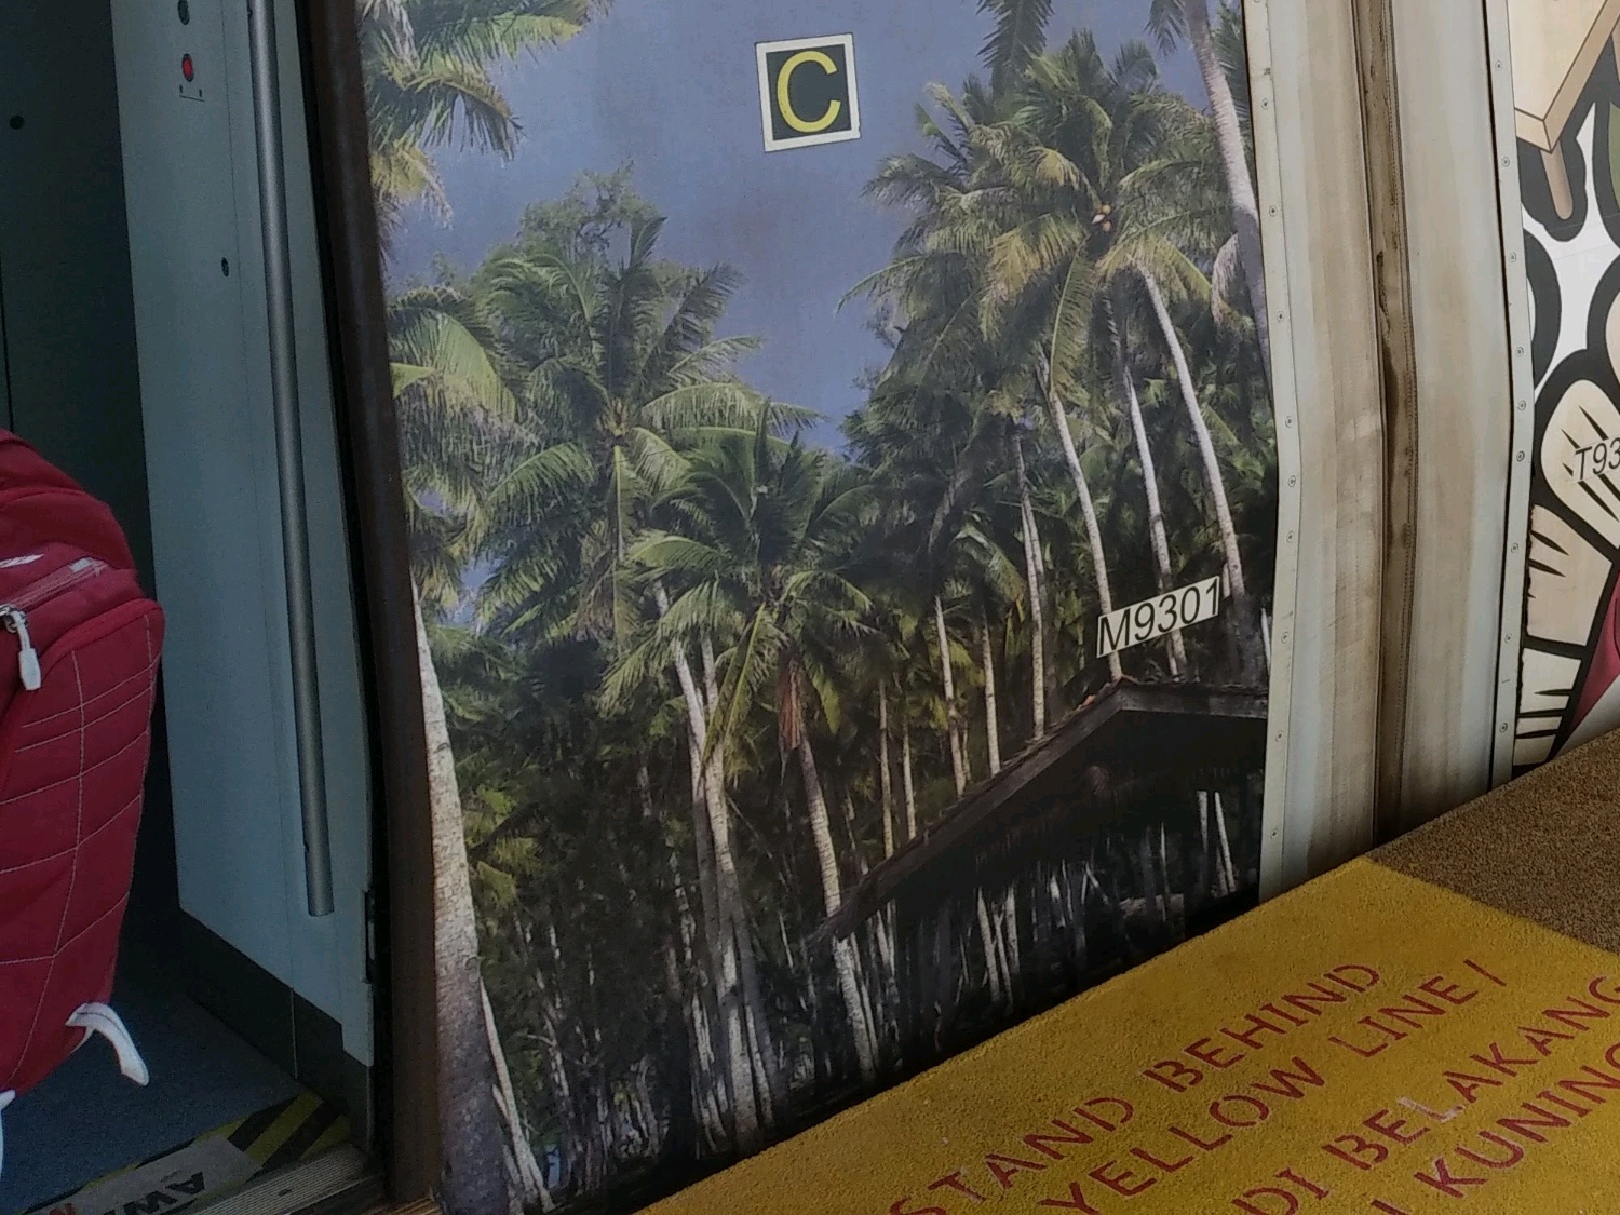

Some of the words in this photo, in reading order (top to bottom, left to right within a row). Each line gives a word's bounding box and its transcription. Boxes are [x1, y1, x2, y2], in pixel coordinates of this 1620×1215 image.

[777, 50, 841, 133] C
[1100, 577, 1219, 655] M9301
[1142, 963, 1380, 1093] BEHIND
[1037, 1056, 1325, 1215] YELLOW
